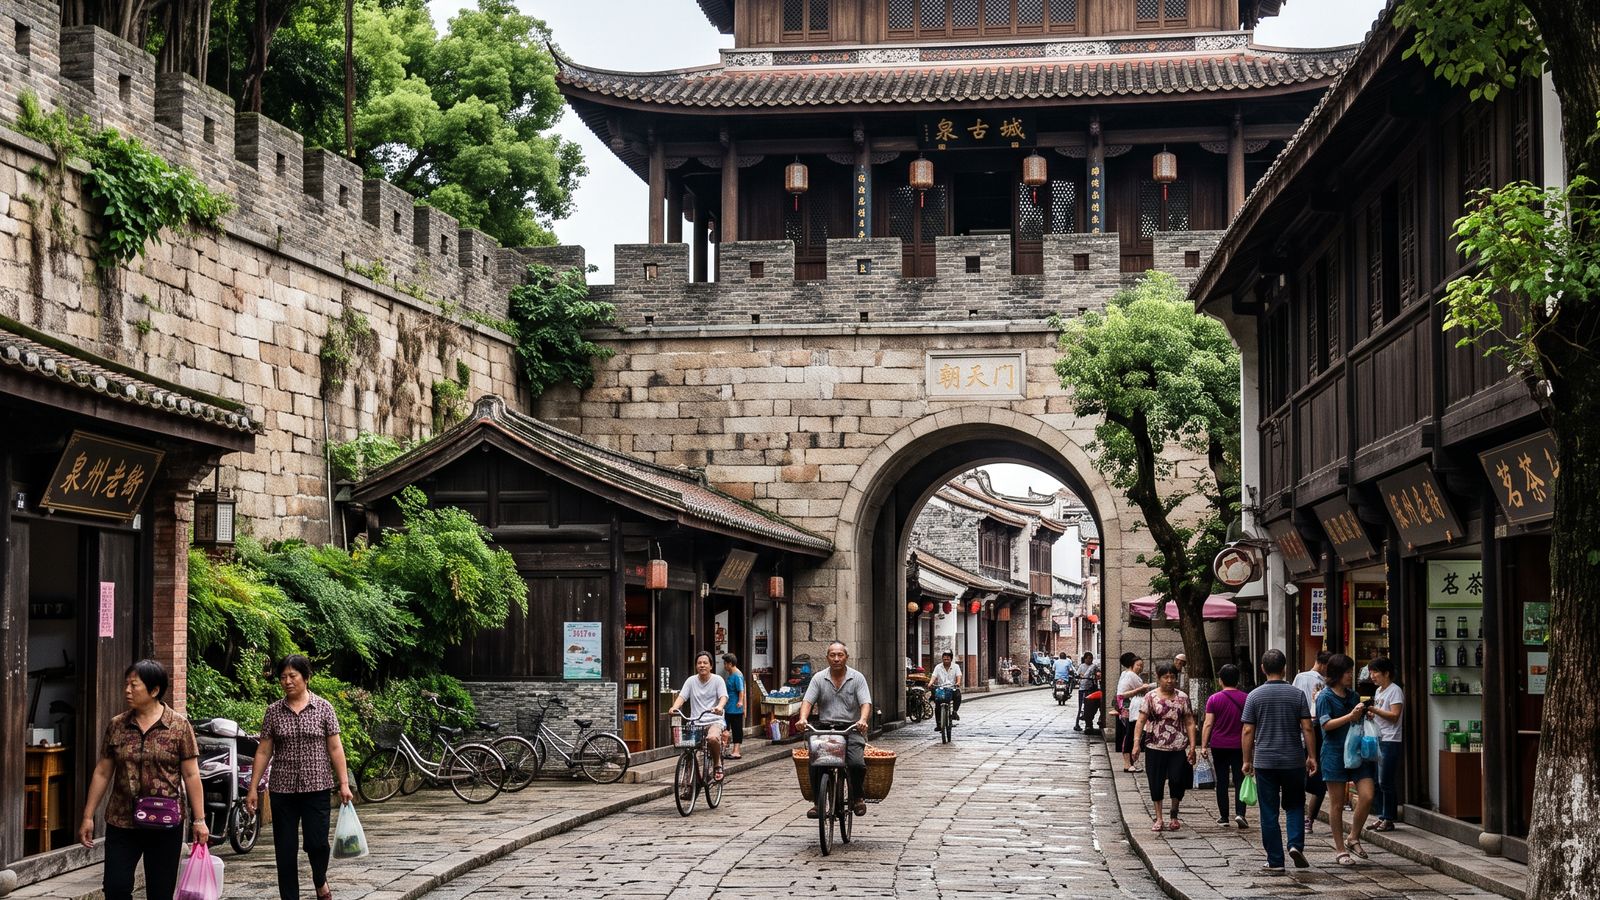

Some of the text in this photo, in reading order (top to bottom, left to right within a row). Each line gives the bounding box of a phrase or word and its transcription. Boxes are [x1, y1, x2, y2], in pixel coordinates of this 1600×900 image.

[935, 117, 1026, 142] 泉古城
[938, 363, 1015, 390] 朝天门
[1441, 571, 1483, 596] 茗茶
